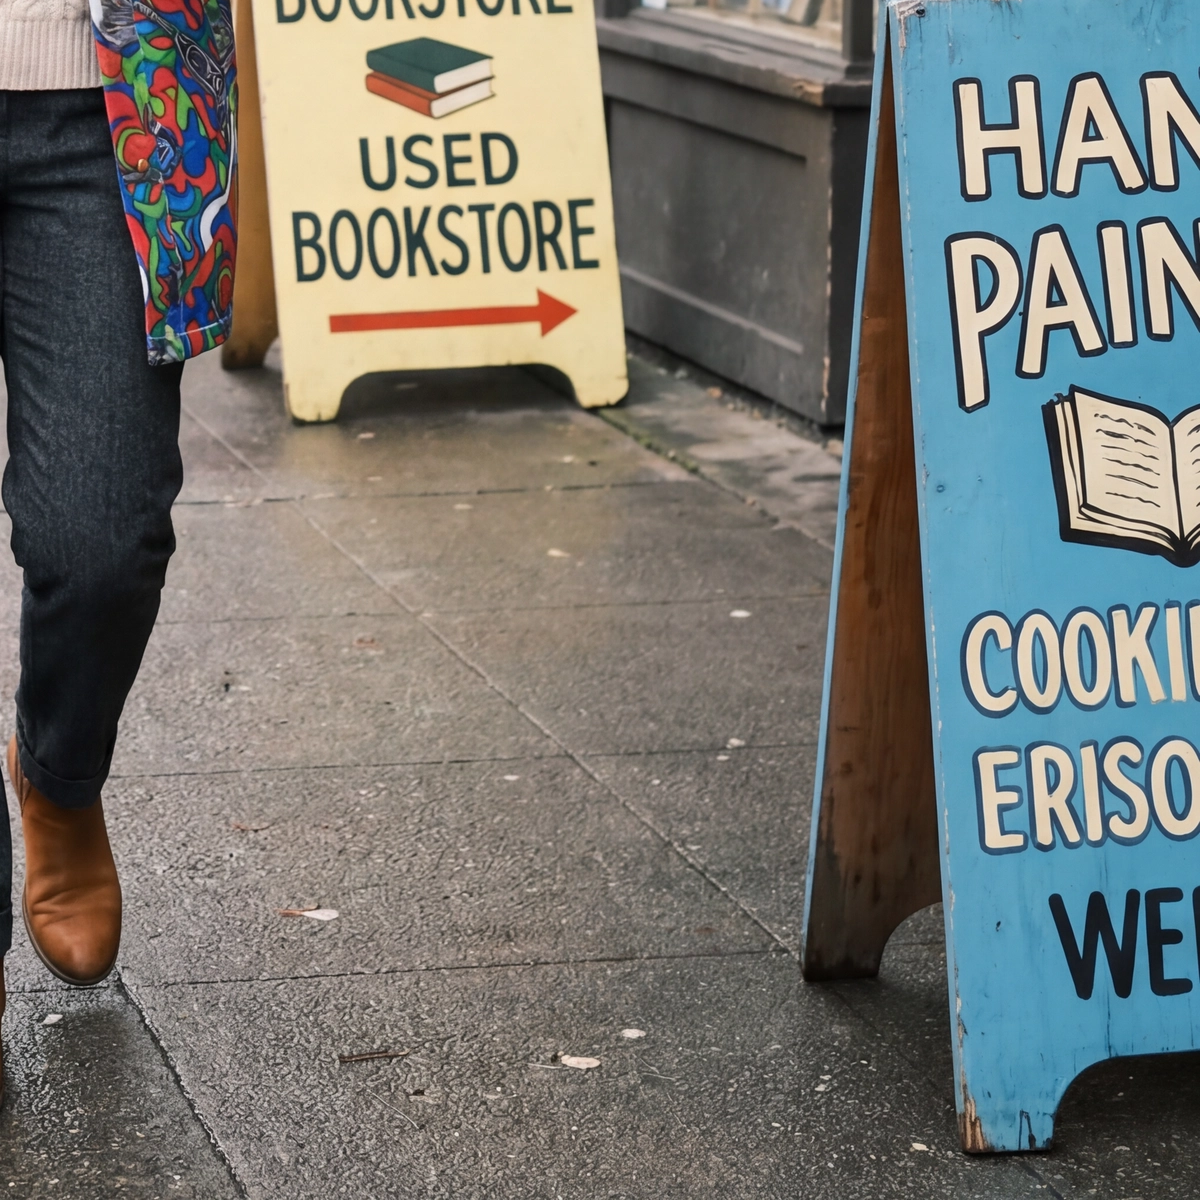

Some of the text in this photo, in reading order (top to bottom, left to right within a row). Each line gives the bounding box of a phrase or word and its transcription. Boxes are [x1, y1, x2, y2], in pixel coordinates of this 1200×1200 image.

[359, 132, 518, 191] USED
[292, 198, 599, 283] BOOKSTORE
[960, 600, 1200, 718] COOKI
[1048, 885, 1200, 1000] WE
